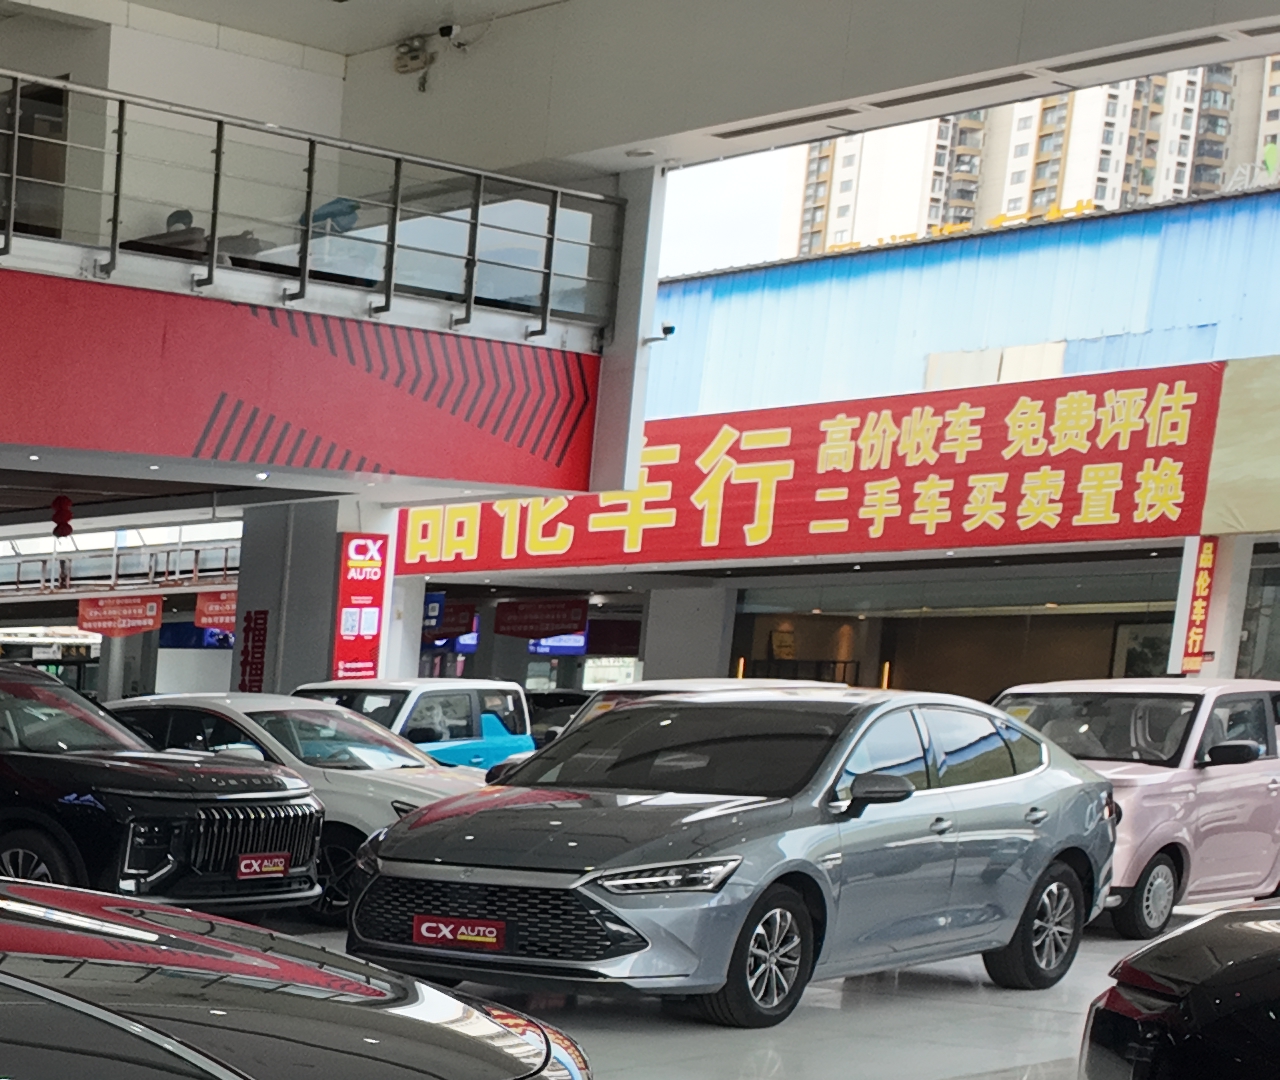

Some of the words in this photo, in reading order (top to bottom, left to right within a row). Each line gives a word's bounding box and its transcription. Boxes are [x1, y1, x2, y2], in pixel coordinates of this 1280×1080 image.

[817, 403, 986, 473] 高价收车
[1001, 380, 1198, 460] 免费评估
[809, 457, 1185, 538] 二手车买卖置换
[348, 539, 383, 561] CX
[347, 568, 382, 580] AUTO
[240, 859, 262, 873] CX
[263, 858, 285, 867] AUTO
[420, 922, 455, 940] CX
[458, 925, 497, 938] AUTO
